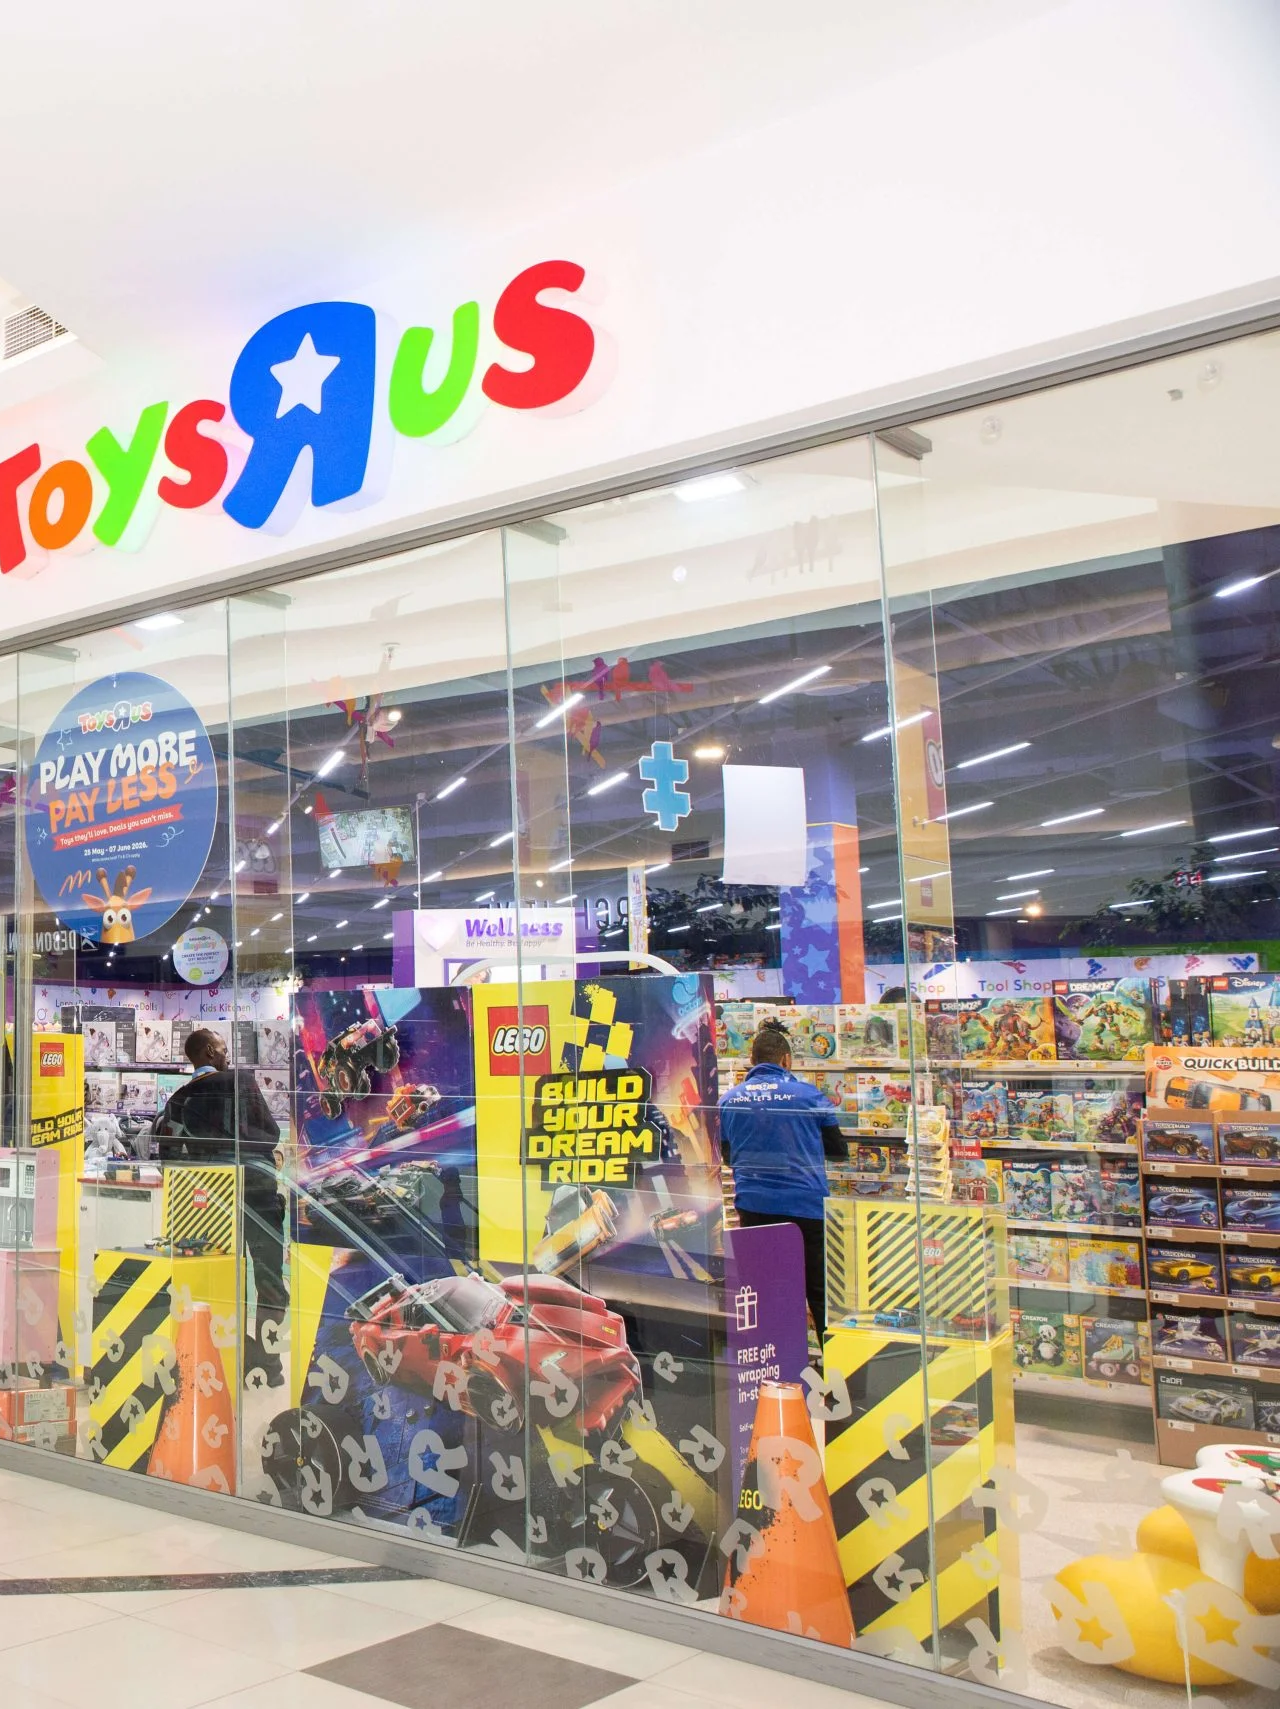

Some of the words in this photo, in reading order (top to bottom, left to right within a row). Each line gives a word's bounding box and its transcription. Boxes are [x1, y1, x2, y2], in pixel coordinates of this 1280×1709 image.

[40, 748, 107, 794] PLAY
[110, 729, 197, 777] MORE
[49, 787, 99, 833] PAY
[106, 762, 177, 814] LESS
[60, 837, 74, 847] Toys
[94, 829, 108, 839] love.
[108, 824, 127, 834] Deals
[127, 820, 139, 830] you
[140, 816, 156, 826] can't
[157, 812, 174, 821] miss.
[92, 847, 105, 856] May
[465, 917, 563, 938] Wellness
[978, 980, 1009, 992] Tool
[1013, 979, 1052, 995] Shop
[1231, 977, 1266, 989] Disney
[140, 1002, 158, 1011] Dolls
[200, 1003, 216, 1013] Kids
[492, 1026, 547, 1055] LEGO
[42, 1052, 63, 1066] LEGO
[541, 1075, 644, 1106] BUILD
[57, 1112, 82, 1127] YOUR
[543, 1102, 638, 1131] YOUR
[32, 1130, 60, 1146] EAM
[63, 1121, 83, 1138] RIDE
[528, 1129, 653, 1158] DREAM
[548, 1157, 629, 1184] RIDE
[922, 1247, 942, 1257] EGO
[737, 1347, 759, 1364] FREE
[760, 1343, 776, 1359] gift
[737, 1364, 780, 1384] wrapping
[738, 1387, 759, 1403] in-st
